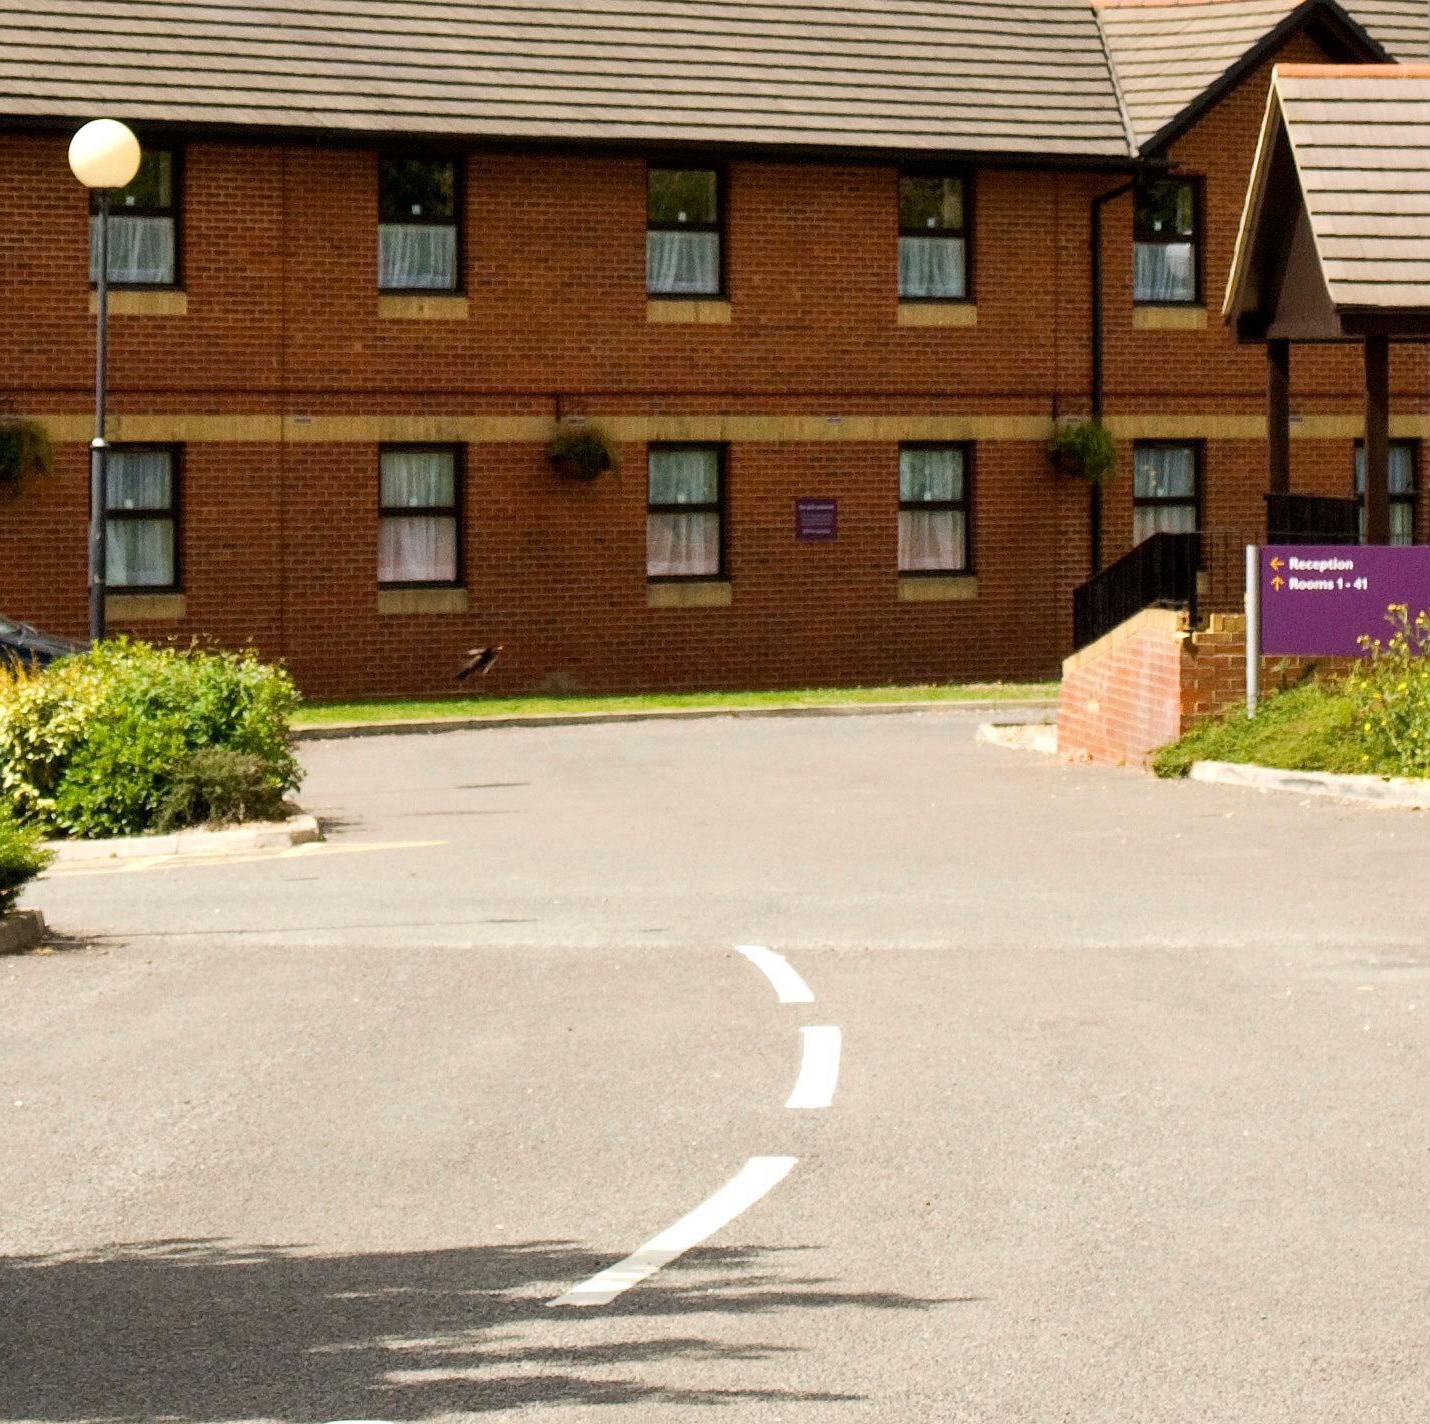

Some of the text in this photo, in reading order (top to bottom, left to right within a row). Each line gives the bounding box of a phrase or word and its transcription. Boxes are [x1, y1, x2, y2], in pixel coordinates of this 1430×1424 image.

[1289, 556, 1354, 573] Reception
[1289, 576, 1334, 590] Rooms
[1337, 576, 1344, 590] 1
[1353, 576, 1368, 590] 41
